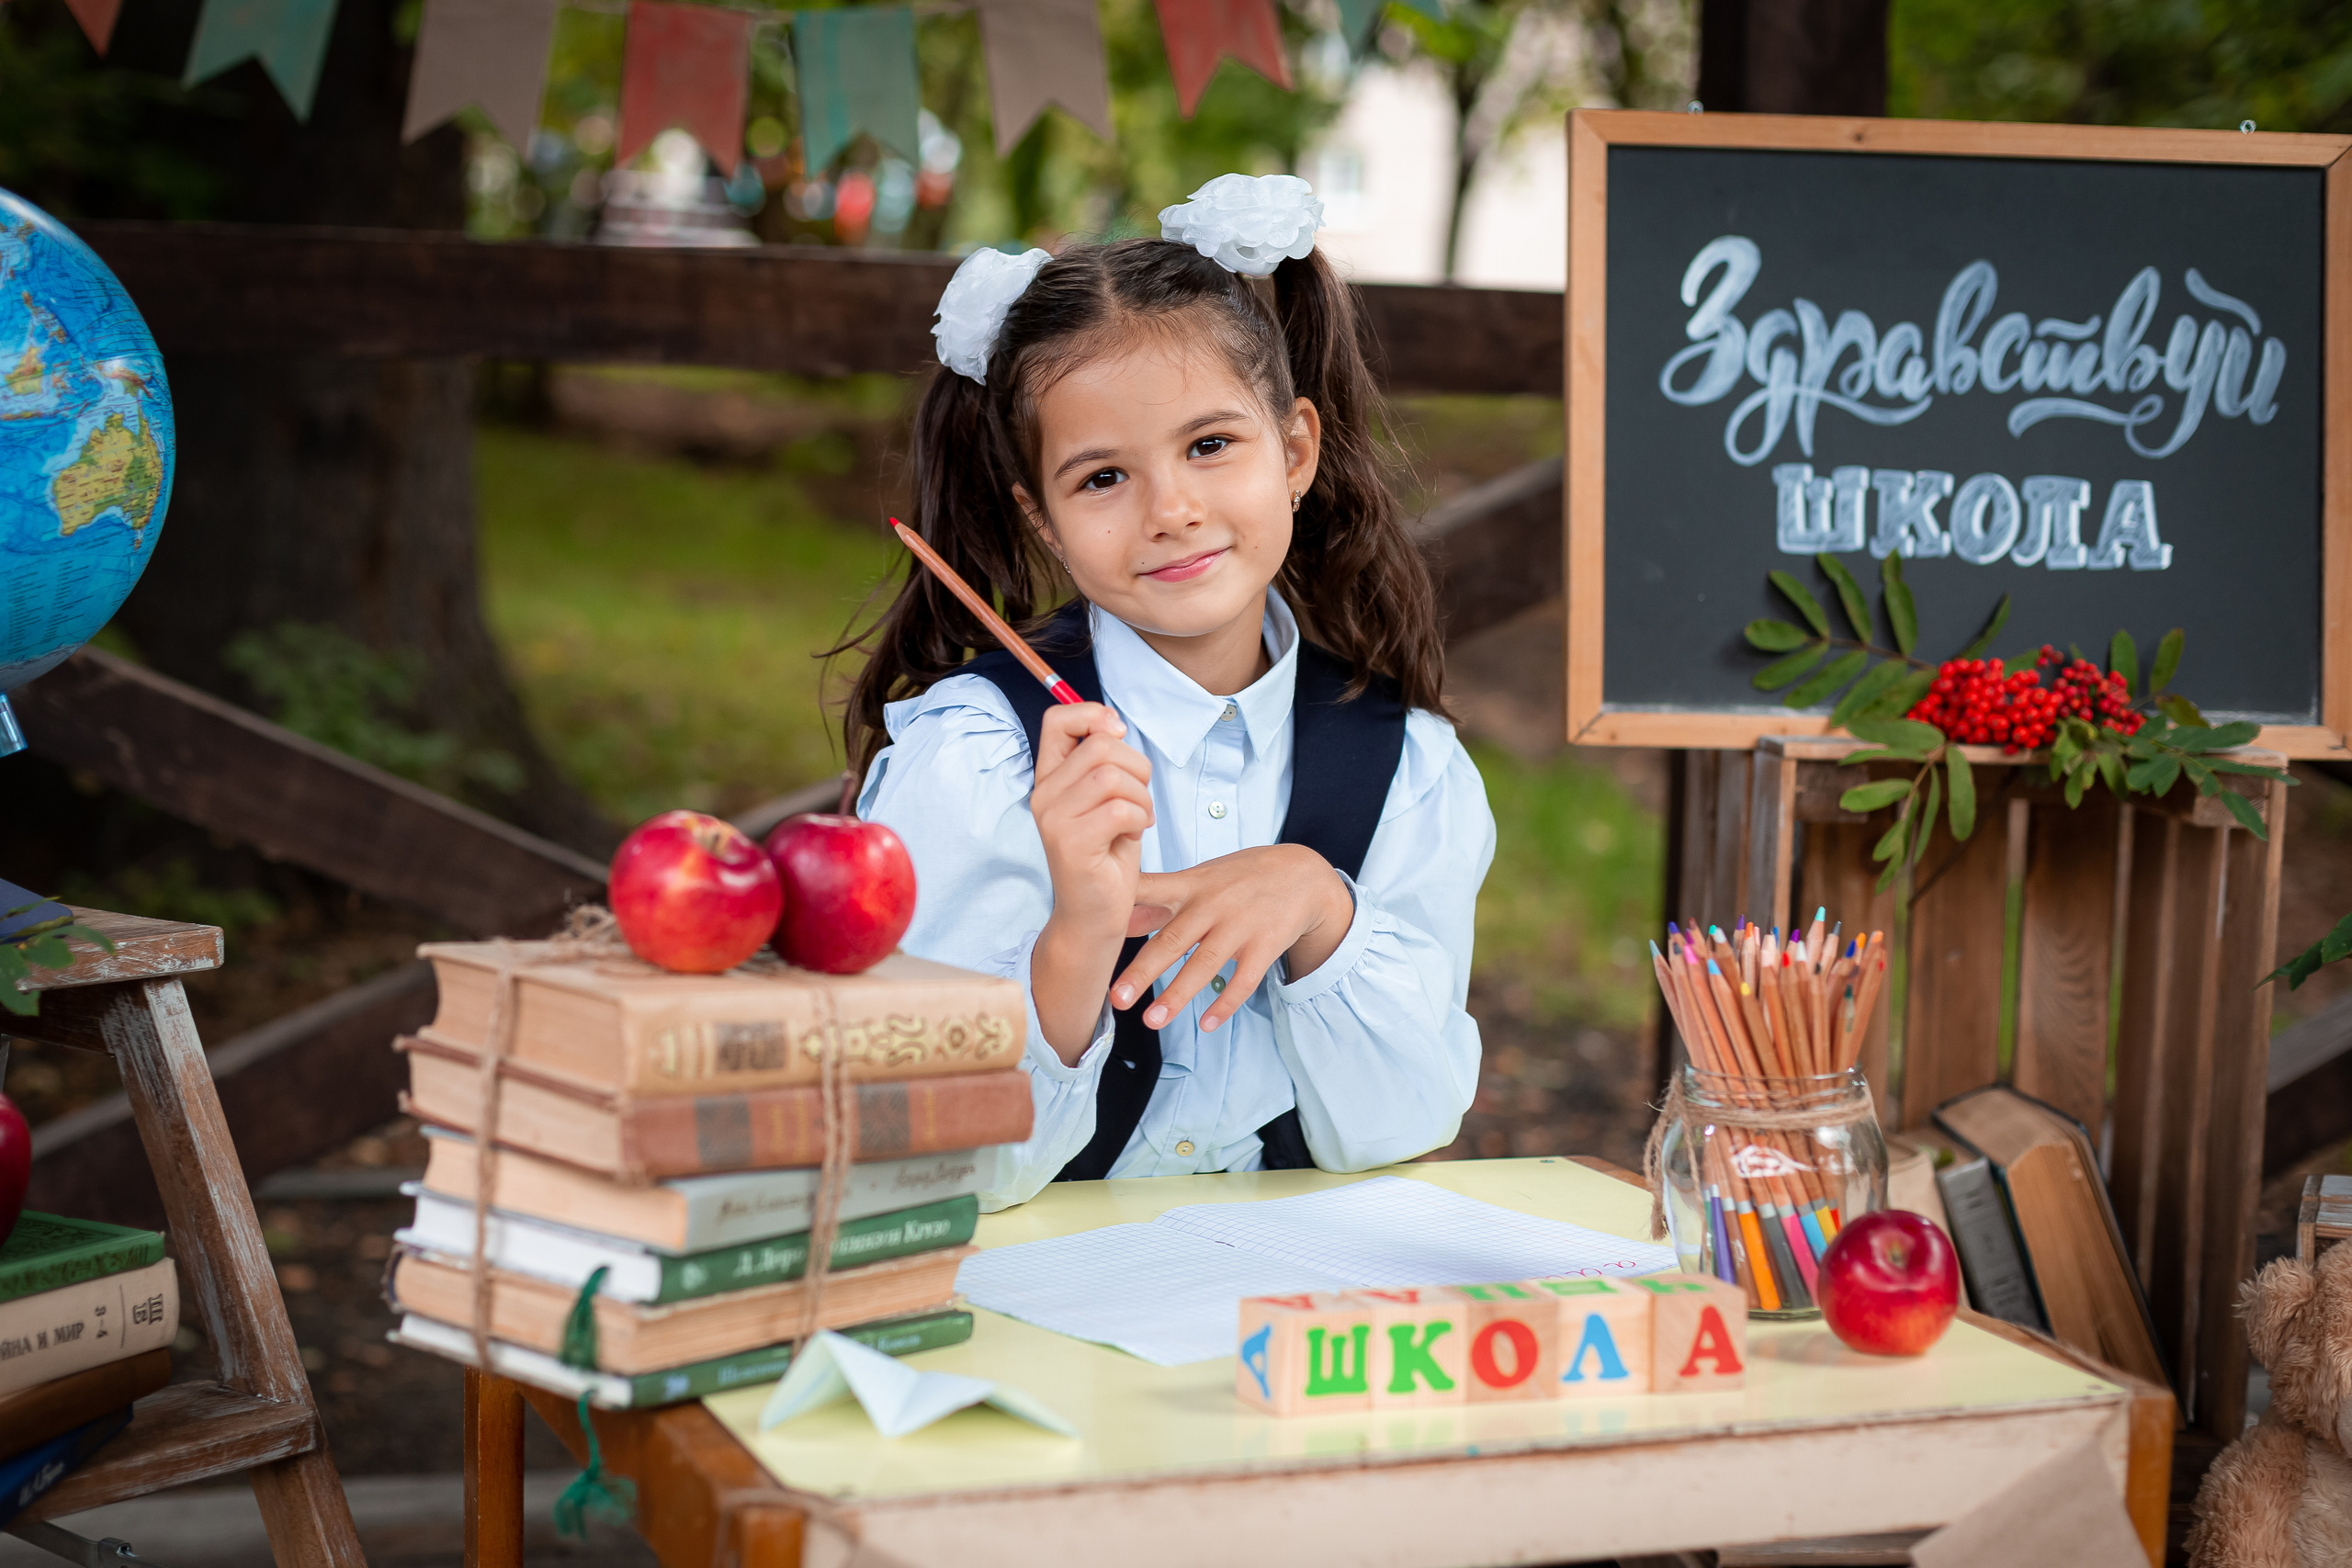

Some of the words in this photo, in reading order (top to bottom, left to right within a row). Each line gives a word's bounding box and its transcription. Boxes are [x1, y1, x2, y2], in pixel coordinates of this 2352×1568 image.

[1660, 235, 2286, 466] Здравствуй
[1771, 463, 2174, 570] ШКОЛА
[53, 1321, 85, 1346] МИР
[1305, 1305, 1743, 1397] ШКОЛА
